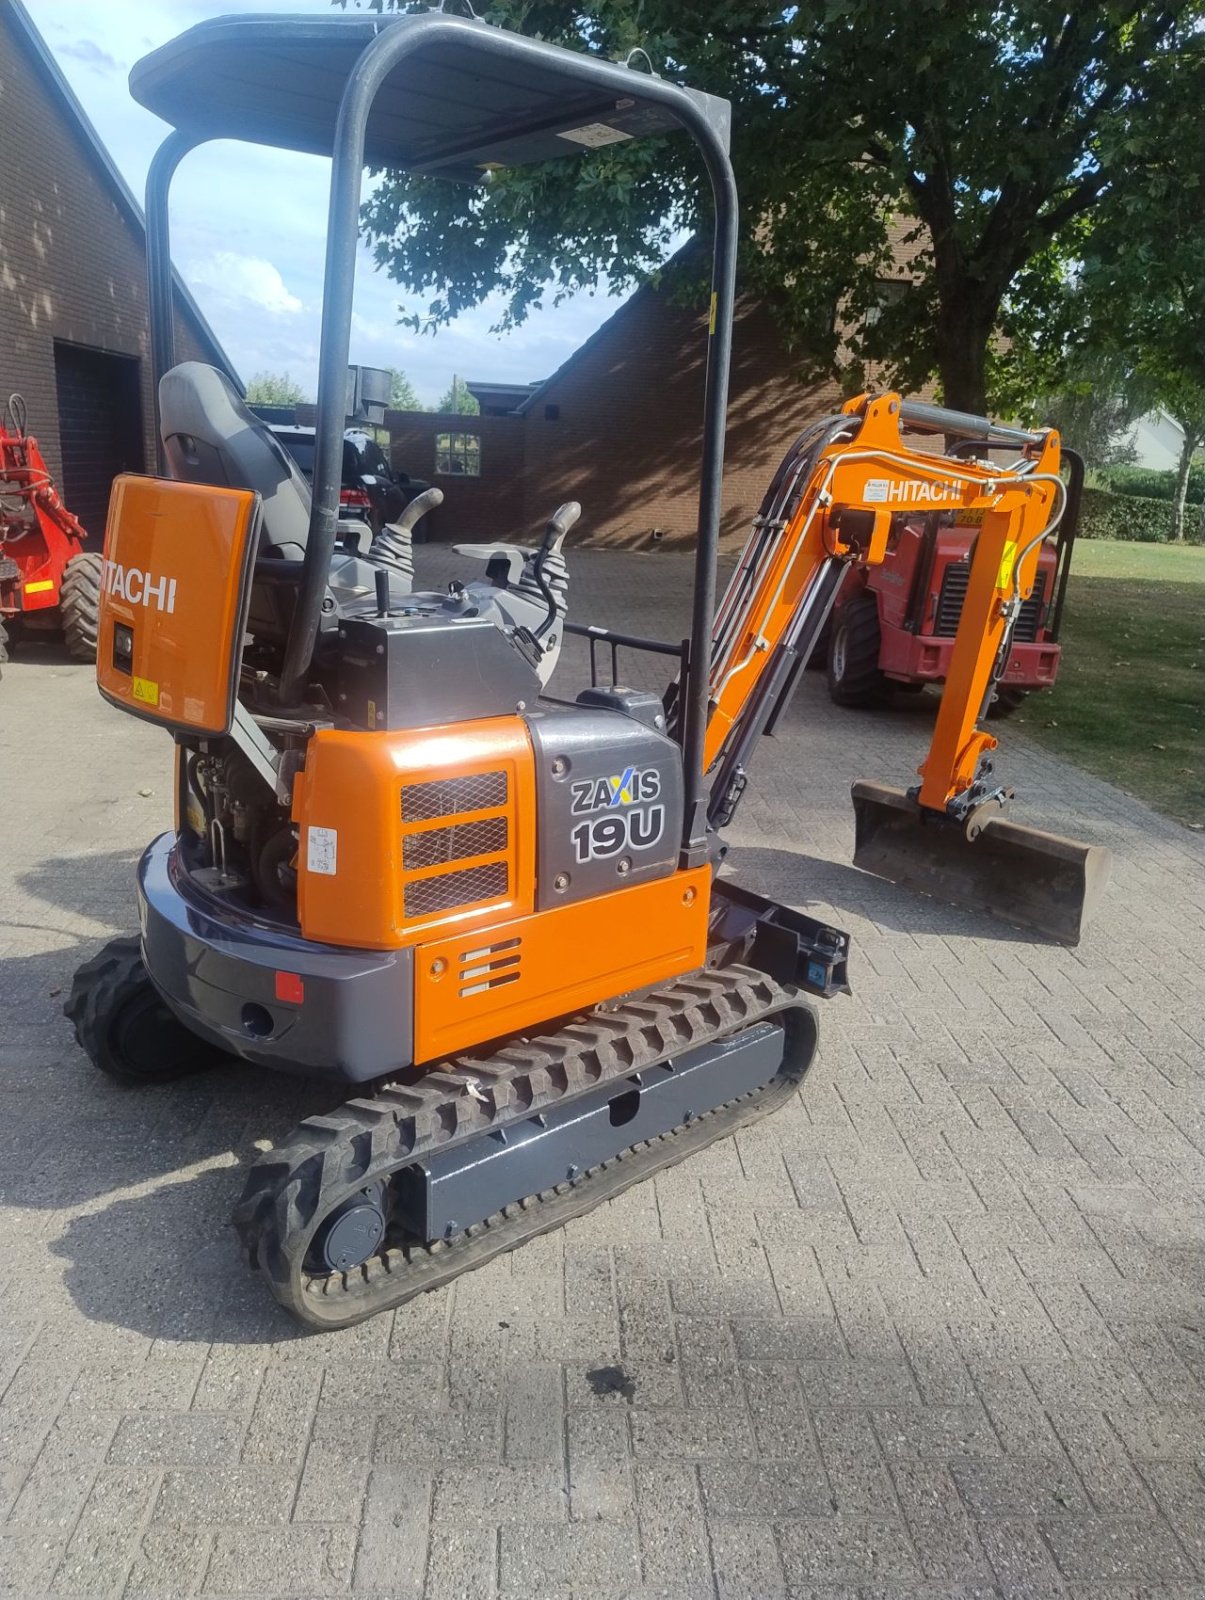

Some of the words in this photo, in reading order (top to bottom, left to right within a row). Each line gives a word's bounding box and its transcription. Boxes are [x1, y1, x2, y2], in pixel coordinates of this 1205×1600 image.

[888, 480, 962, 502] HITACHI
[101, 560, 177, 614] ITACHI
[571, 766, 660, 815] ZAXIS
[571, 804, 664, 863] 19U
